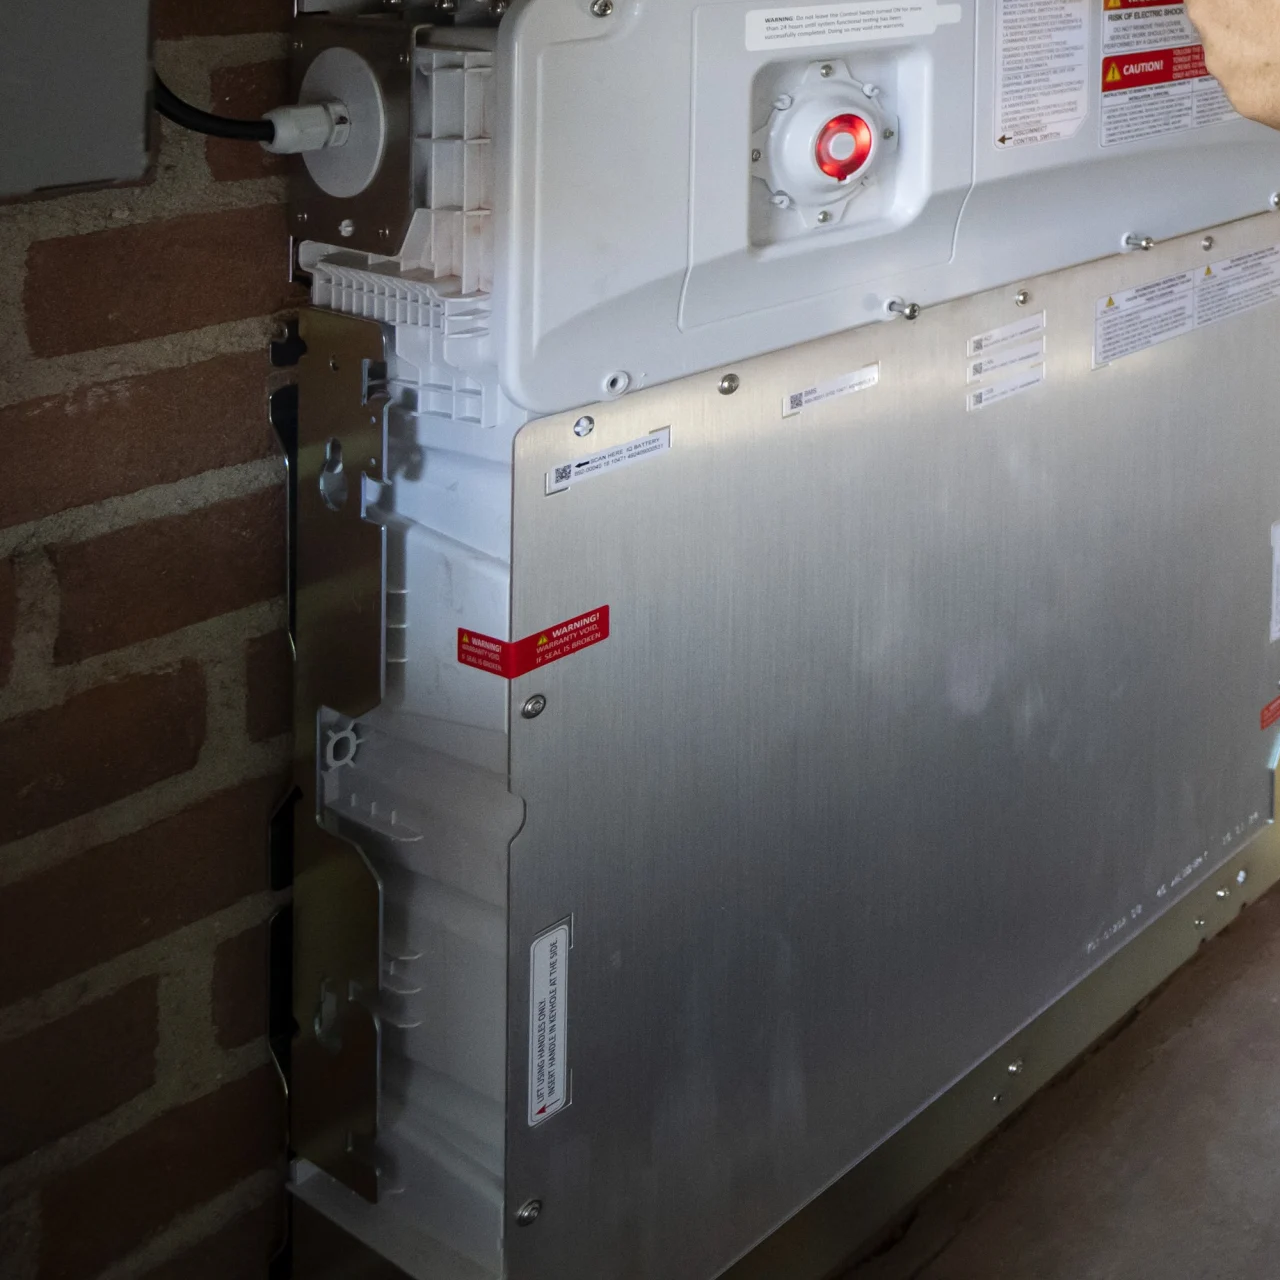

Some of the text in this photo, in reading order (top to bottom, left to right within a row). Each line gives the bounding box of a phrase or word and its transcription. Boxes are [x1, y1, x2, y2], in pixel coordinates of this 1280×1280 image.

[1108, 7, 1184, 22] RISK OF ELECTRIC SHOCK
[805, 21, 817, 29] until
[817, 21, 835, 29] system
[765, 31, 796, 40] successfully
[827, 27, 843, 35] Doing
[1123, 60, 1164, 75] CAUTION!
[1013, 125, 1047, 136] DISCONNECT
[1013, 132, 1060, 145] CONTROL SWITCH
[591, 455, 606, 464] SCAN
[608, 449, 624, 459] HERE
[633, 438, 660, 450] BATTERY
[552, 612, 600, 638] WARNING!
[471, 637, 502, 653] WARNING!
[536, 632, 578, 653] WARRANTY
[462, 644, 488, 657] WARRANTY
[544, 649, 562, 660] SEAL
[563, 645, 570, 653] IS
[466, 655, 478, 664] SEAL
[549, 958, 557, 975] THE
[549, 976, 557, 986] AT
[549, 986, 557, 1026] KEYHOLE
[549, 1026, 557, 1036] IN
[537, 998, 546, 1104] LIFT USING HANDLES ONLY.
[548, 1037, 557, 1072] HANDLE
[547, 1073, 556, 1098] INSERT
